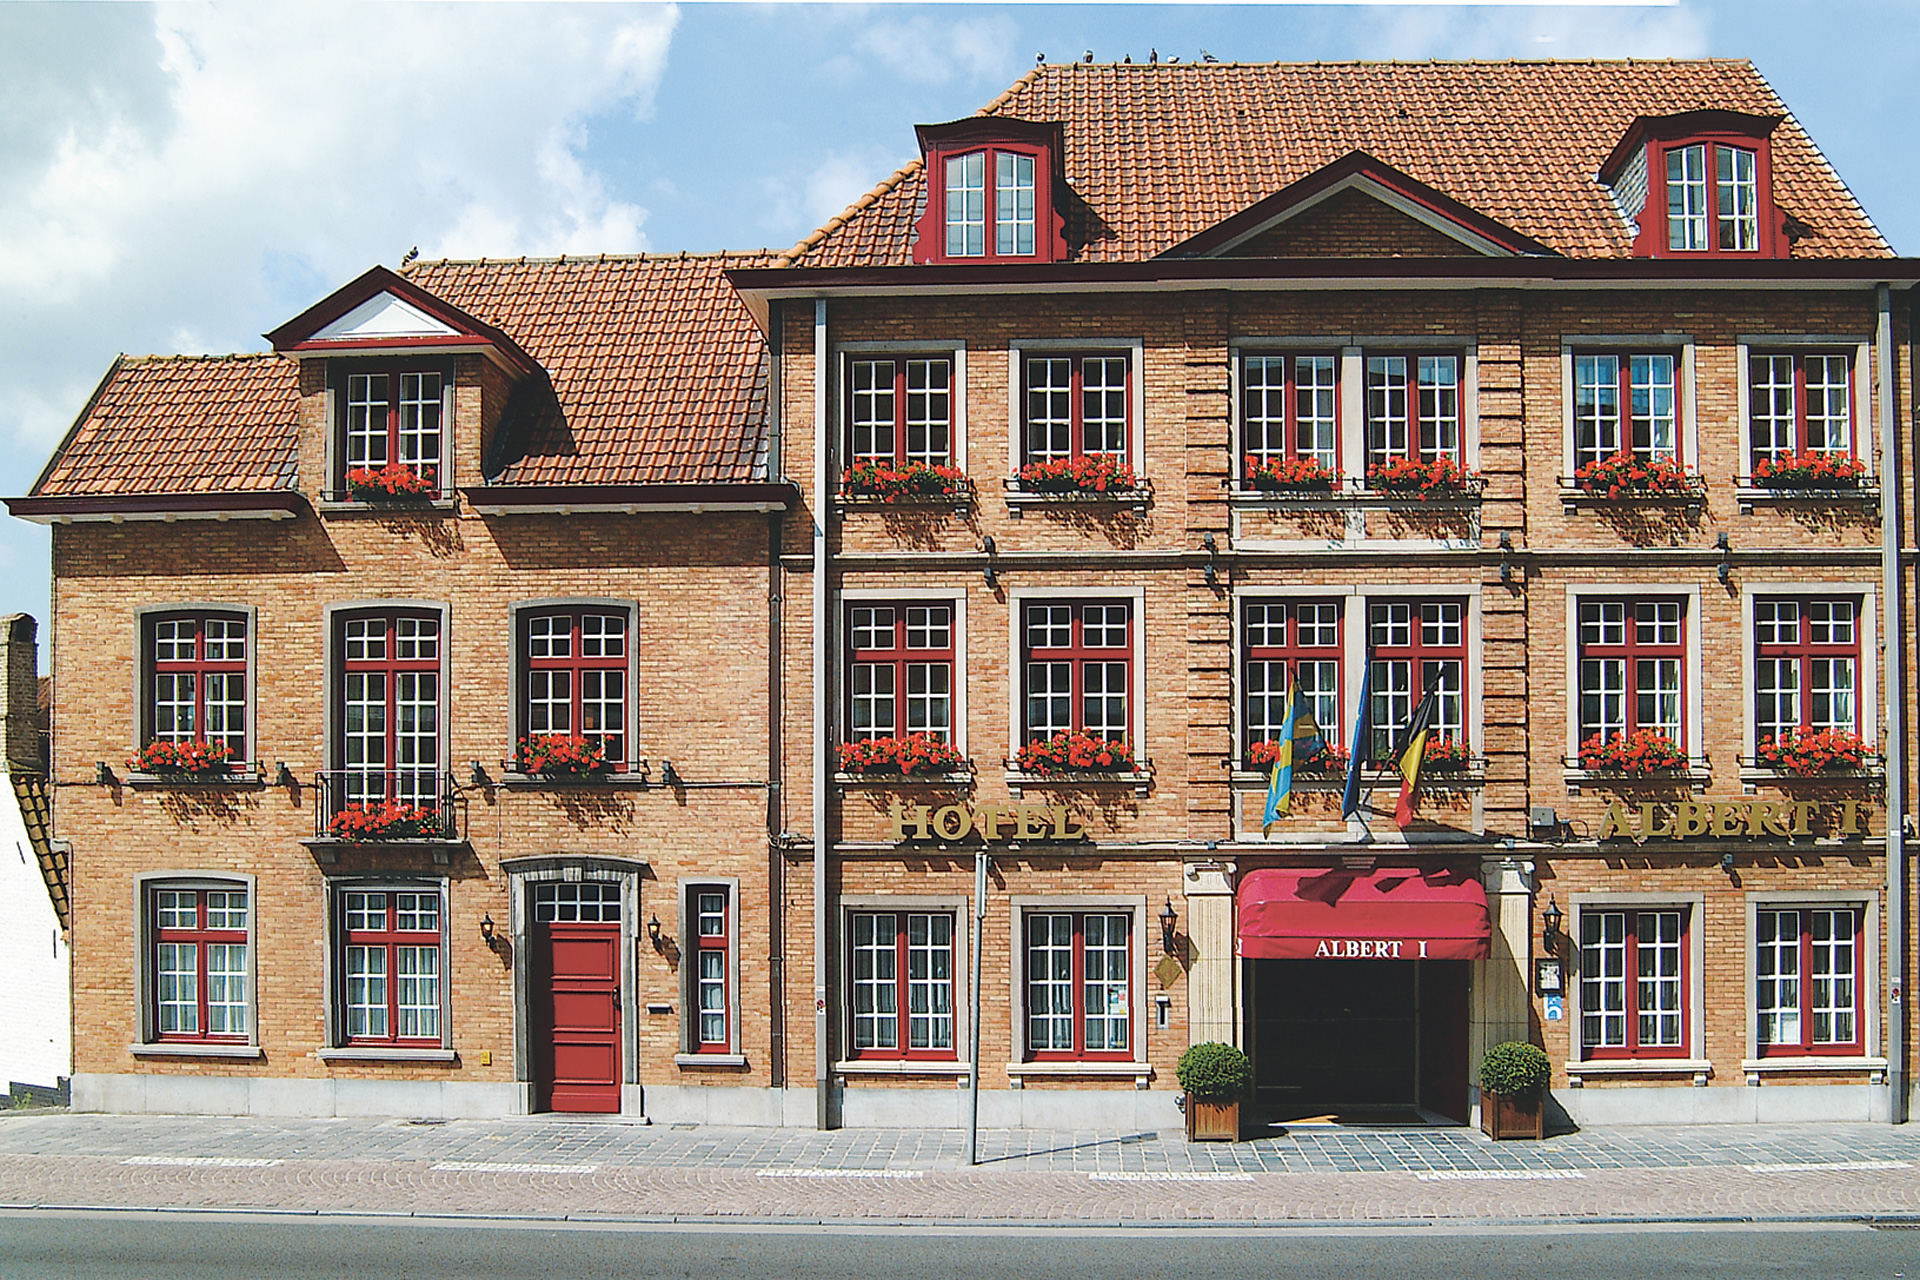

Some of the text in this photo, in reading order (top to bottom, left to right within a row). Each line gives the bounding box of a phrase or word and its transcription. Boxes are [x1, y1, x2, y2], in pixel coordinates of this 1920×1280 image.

[889, 804, 1085, 840] HOTEL
[1599, 800, 1862, 836] ALBERT I
[1315, 940, 1428, 958] ALBERT I
